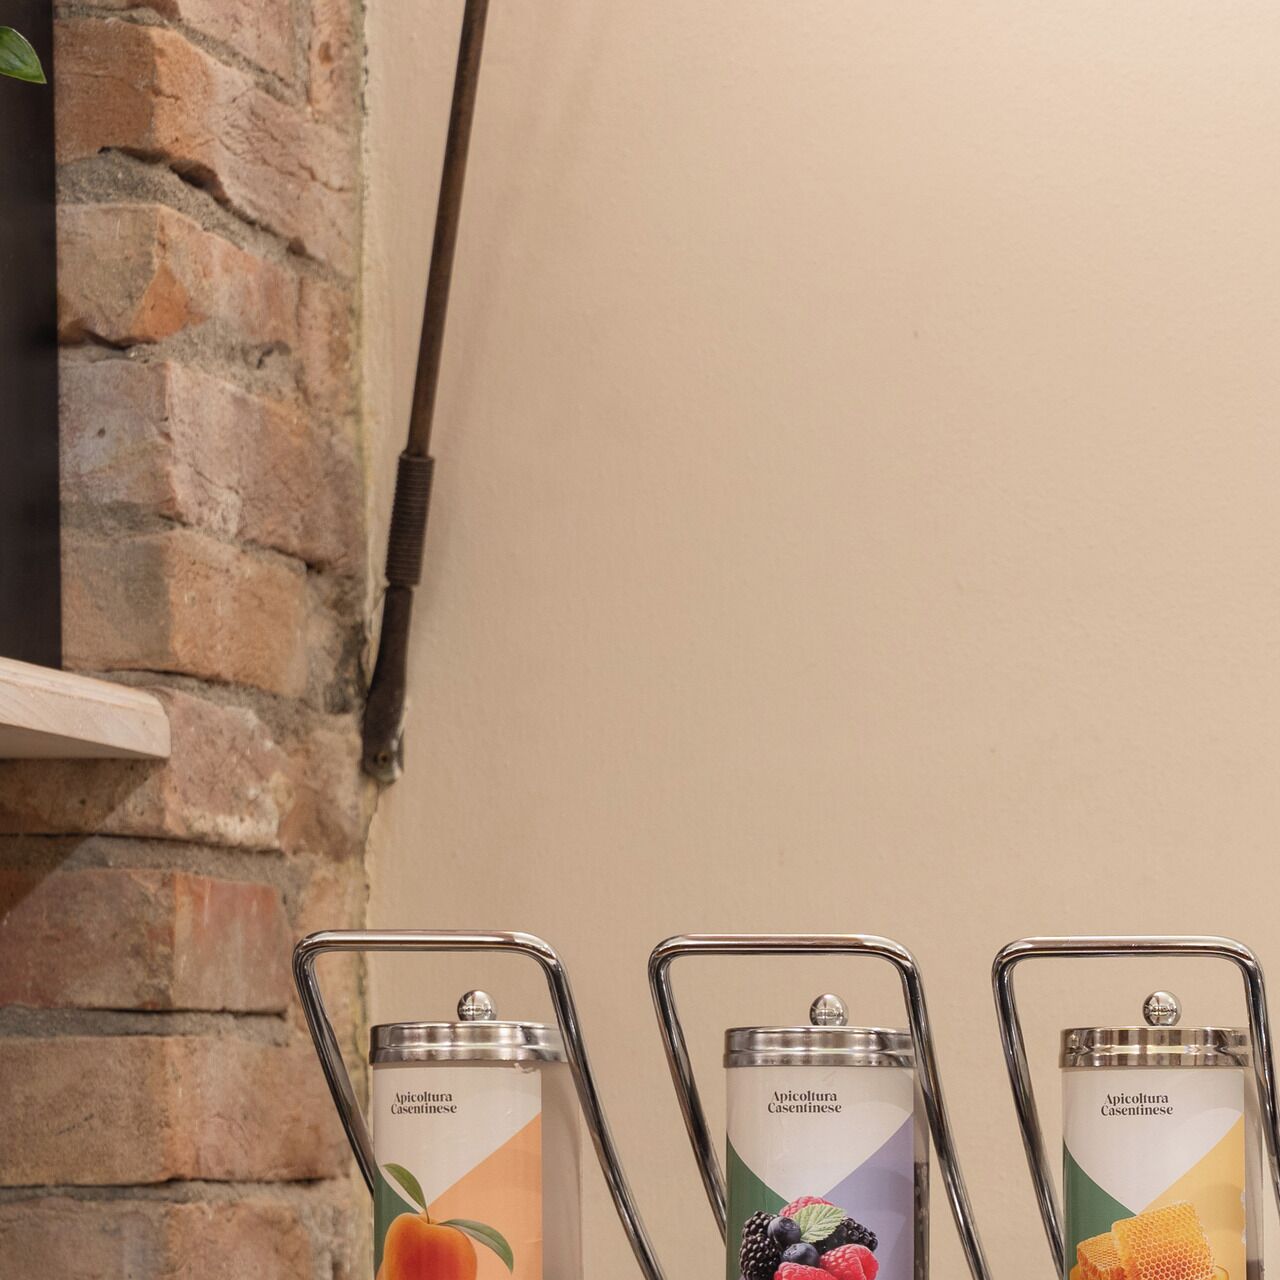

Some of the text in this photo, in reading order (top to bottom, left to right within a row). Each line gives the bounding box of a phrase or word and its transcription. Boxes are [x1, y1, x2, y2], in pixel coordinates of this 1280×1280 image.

[393, 1091, 453, 1104] Apicoltura
[772, 1090, 837, 1103] Apicoltura
[1104, 1093, 1169, 1106] Apicoltura
[391, 1103, 458, 1115] Casentinese
[767, 1102, 842, 1114] Casentinese
[1101, 1104, 1174, 1116] Casentinese
